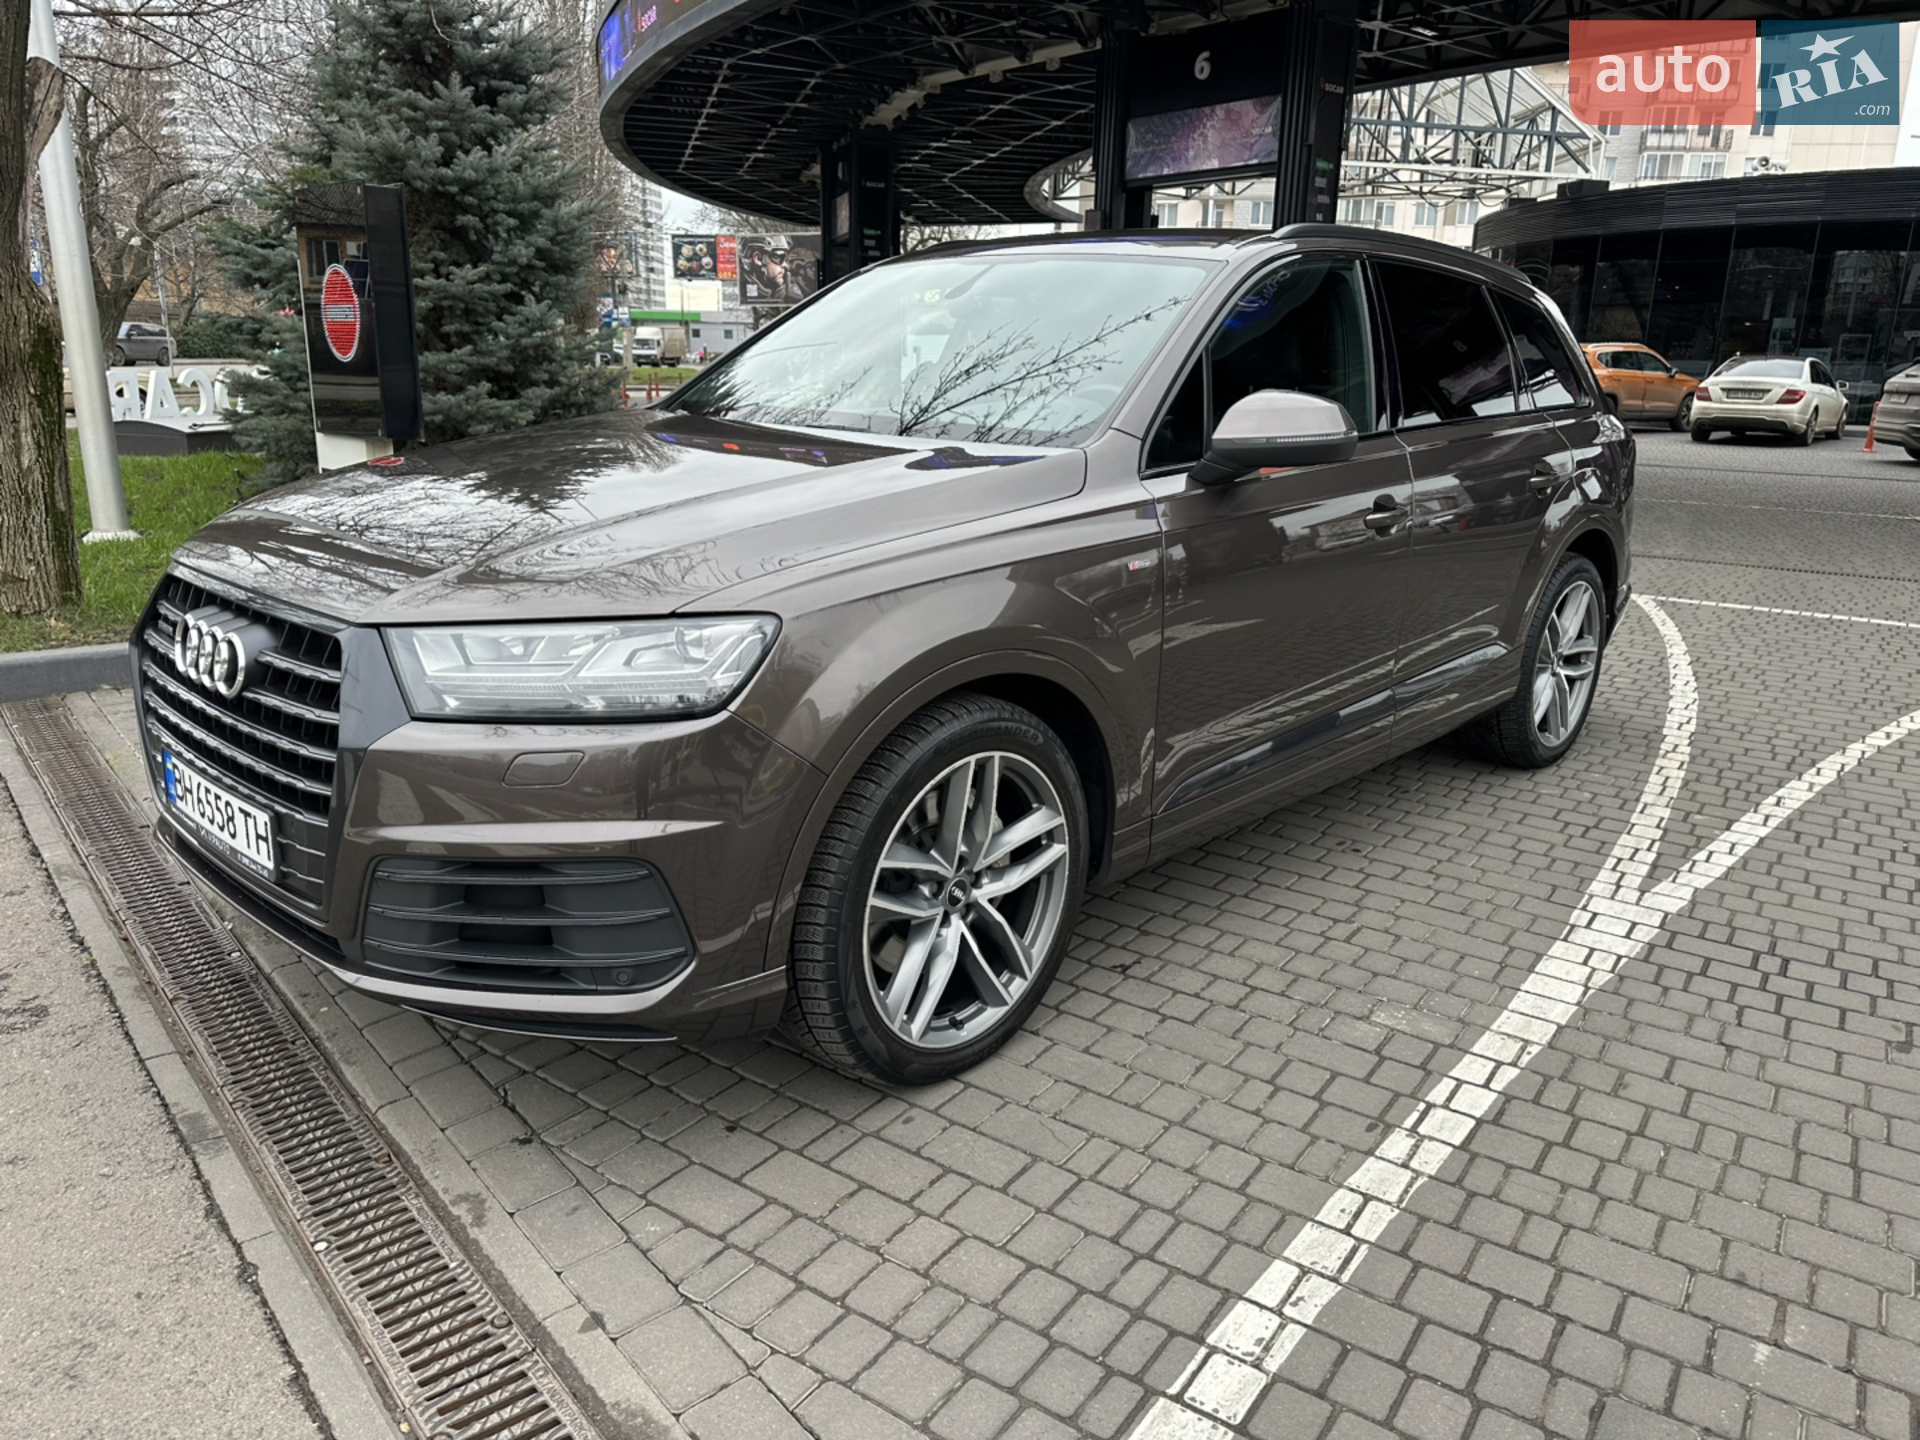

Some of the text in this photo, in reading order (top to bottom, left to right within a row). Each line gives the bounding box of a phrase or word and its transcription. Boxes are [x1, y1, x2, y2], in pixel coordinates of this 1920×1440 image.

[1194, 51, 1211, 81] 6
[1324, 82, 1345, 95] SOCAR
[196, 781, 238, 840] 6558
